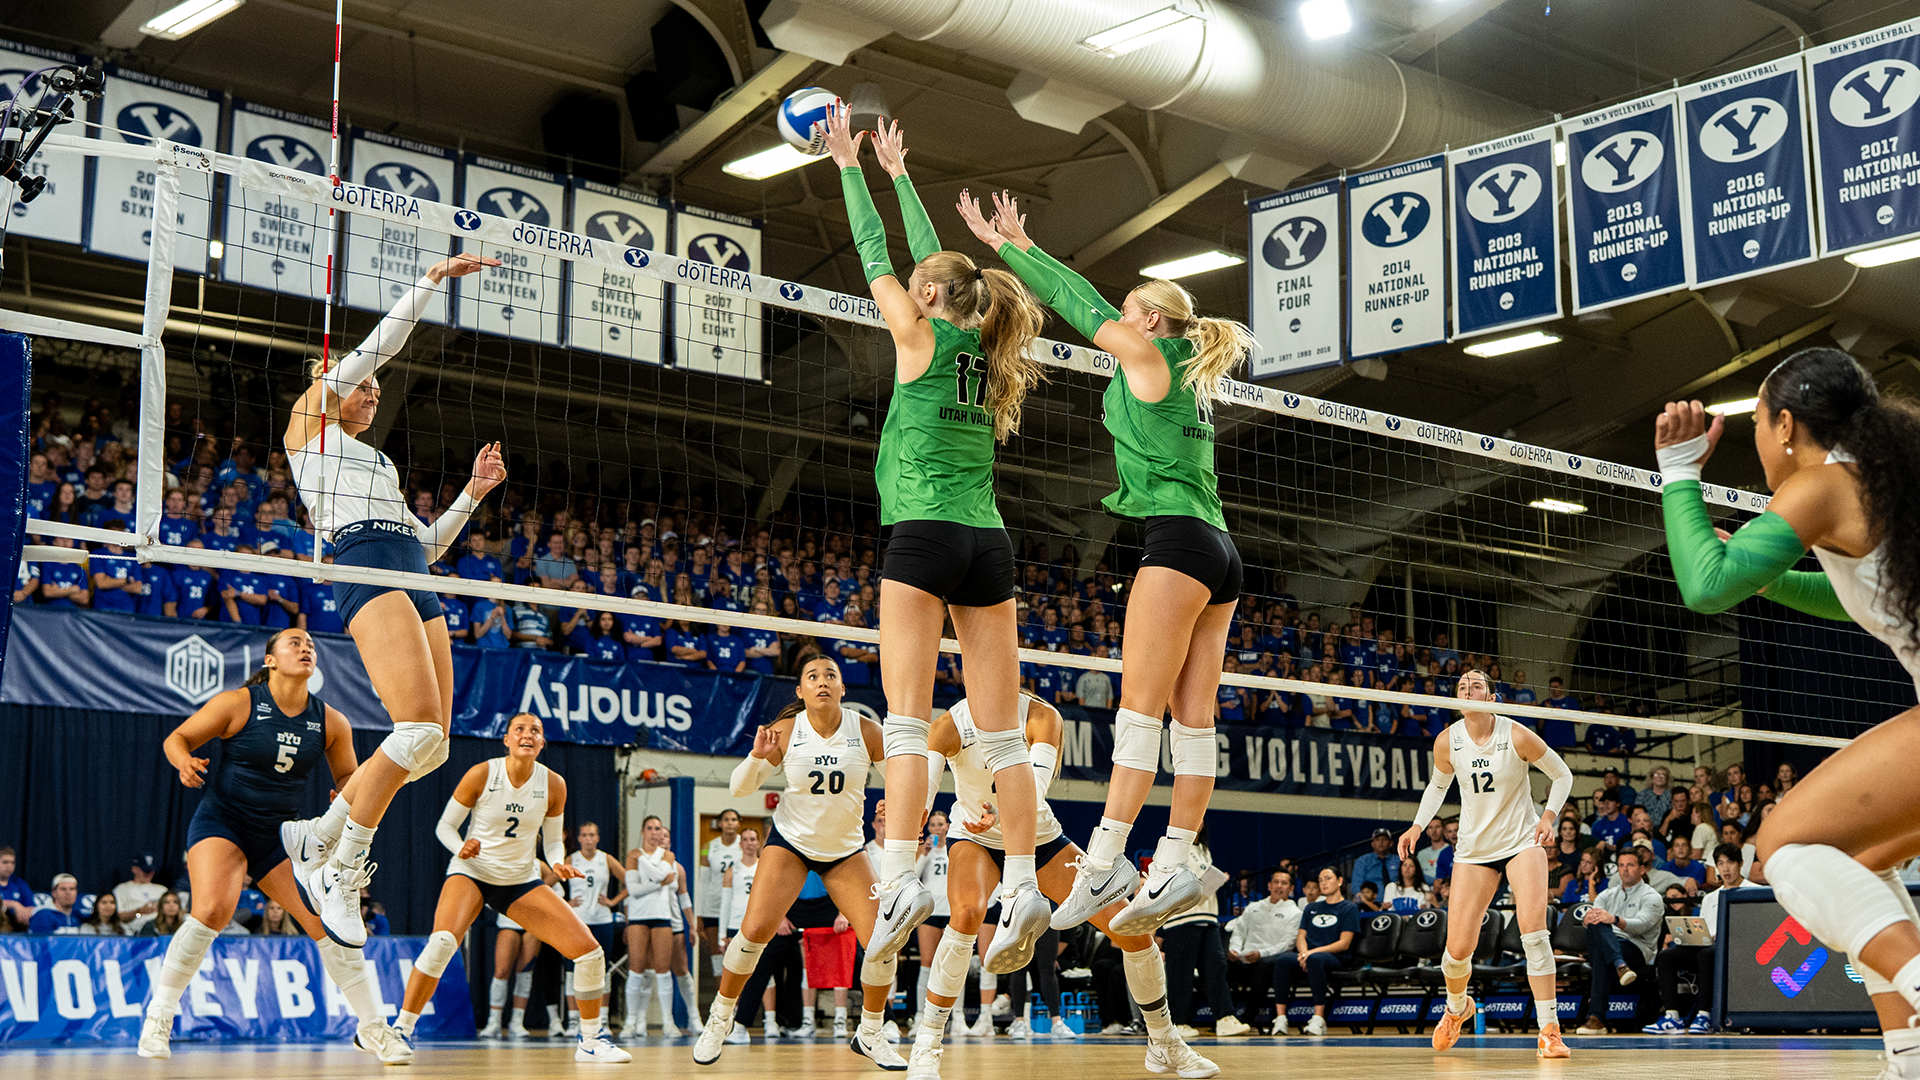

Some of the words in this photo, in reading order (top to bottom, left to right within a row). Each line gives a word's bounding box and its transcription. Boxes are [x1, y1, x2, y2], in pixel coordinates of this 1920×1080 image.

[1830, 40, 1857, 55] MEN'S
[1860, 24, 1914, 47] VOLLEYBALL
[117, 67, 158, 85] WOMEN'S
[160, 79, 209, 98] VOLLEYBALL
[1700, 77, 1726, 92] MEN'S
[1728, 64, 1779, 85] VOLLEYBALL
[1843, 67, 1905, 120] Y
[1582, 113, 1607, 126] MEN'S
[1609, 99, 1655, 118] VOLLEYBALL
[1713, 105, 1770, 156] Y
[180, 148, 205, 158] Senoh
[364, 130, 400, 146] WOMEN'S
[401, 140, 445, 156] VOLLEYBALL
[1468, 143, 1491, 157] MEN'S
[1492, 133, 1535, 151] VOLLEYBALL
[1861, 136, 1898, 160] 2017
[476, 156, 511, 172] WOMEN'S
[512, 164, 555, 182] VOLLEYBALL
[1358, 170, 1390, 185] WOMEN'S
[1391, 160, 1433, 177] VOLLEYBALL
[1595, 138, 1648, 187] Y
[1843, 151, 1920, 183] NATIONAL
[584, 181, 618, 196] WOMEN'S
[619, 189, 659, 206] VOLLEYBALL
[1478, 170, 1528, 216] Y
[1727, 172, 1765, 195] 2016
[1260, 193, 1291, 210] WOMEN'S
[1291, 186, 1329, 203] VOLLEYBALL
[1713, 186, 1784, 217] NATIONAL
[265, 201, 299, 219] 2016
[685, 205, 715, 219] WOMEN'S
[716, 210, 753, 227] VOLLEYBALL
[1372, 196, 1420, 243] Y
[1607, 201, 1643, 223] 2013
[1709, 203, 1791, 236] RUNNER-UP
[260, 217, 305, 237] SWEET
[385, 227, 415, 244] 2017
[1593, 215, 1663, 245] NATIONAL
[252, 231, 311, 254] SIXTEEN
[378, 242, 422, 262] SWEET
[1272, 221, 1317, 266] Y
[1488, 233, 1522, 253] 2003
[1589, 231, 1669, 263] RUNNER-UP
[495, 251, 527, 267] 2020
[1383, 260, 1411, 276] 2014
[1473, 247, 1539, 273] NATIONAL
[490, 266, 532, 284] SWEET
[603, 272, 631, 289] 2021
[1277, 275, 1313, 295] FINAL
[1369, 273, 1425, 295] NATIONAL
[1470, 262, 1544, 290] RUNNER-UP
[483, 281, 537, 301] SIXTEEN
[598, 288, 638, 304] SWEET
[705, 294, 732, 308] 2007
[1279, 293, 1311, 312] FOUR
[1365, 288, 1429, 313] RUNNER-UP
[591, 301, 642, 321] SIXTEEN
[703, 307, 735, 324] ELITE
[829, 293, 885, 320] dōTER
[702, 323, 736, 339] EIGHT
[956, 352, 988, 408] 17
[939, 406, 968, 423] UTAH
[970, 412, 996, 428] VALLE
[1182, 425, 1207, 441] UTAH
[372, 521, 412, 537] NIKE
[173, 648, 218, 697] ROC
[519, 664, 693, 732] smarty
[276, 732, 302, 745] BYU
[274, 744, 298, 773] 5
[814, 755, 838, 766] BYU
[1472, 759, 1490, 768] BYU
[808, 770, 845, 795] 20
[1471, 771, 1495, 794] 12
[505, 803, 524, 813] BYU
[504, 816, 520, 838] 2
[934, 863, 947, 875] 21
[586, 876, 594, 888] 9
